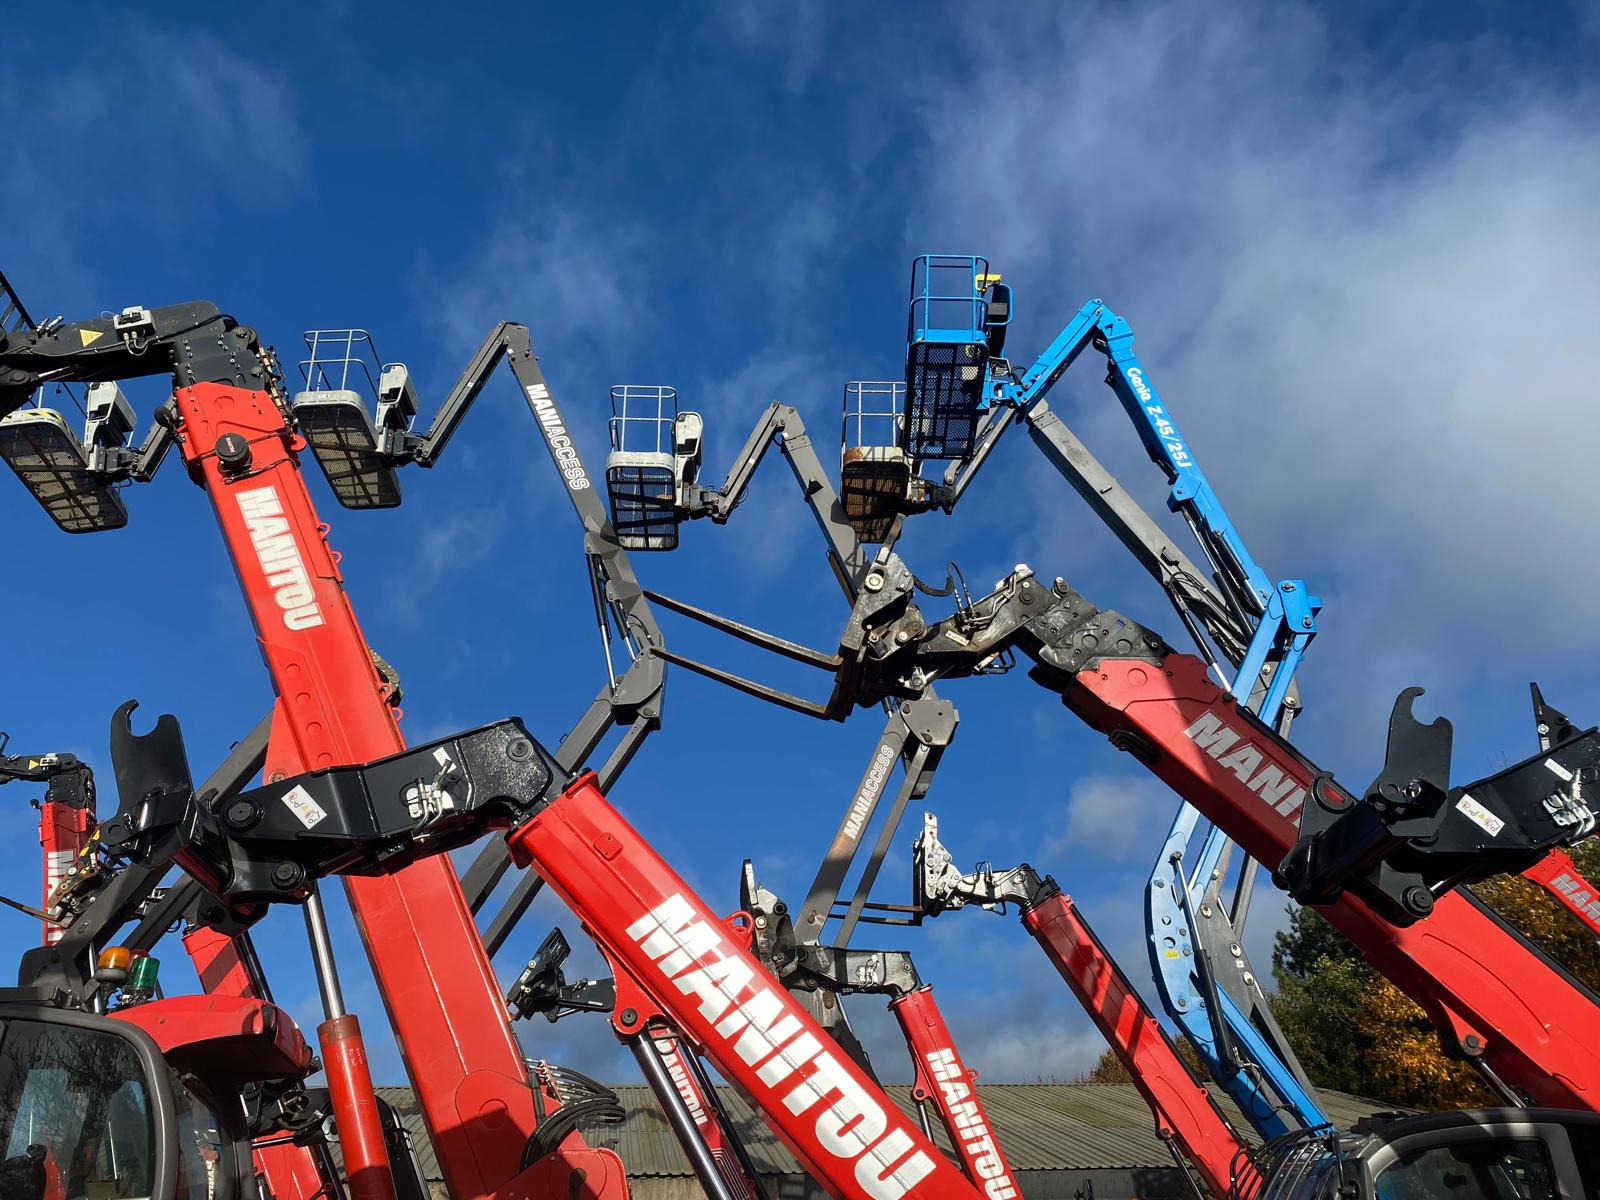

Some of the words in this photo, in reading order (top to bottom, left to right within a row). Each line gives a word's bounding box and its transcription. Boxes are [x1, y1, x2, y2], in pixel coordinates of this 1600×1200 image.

[526, 383, 590, 490] MANIACCESS
[1127, 367, 1151, 403] Genie
[234, 485, 327, 631] MANITOU
[844, 744, 894, 840] MANIACCESS
[1183, 709, 1307, 830] MANI
[625, 892, 937, 1200] MANITOU
[926, 1048, 1017, 1200] MANITOU
